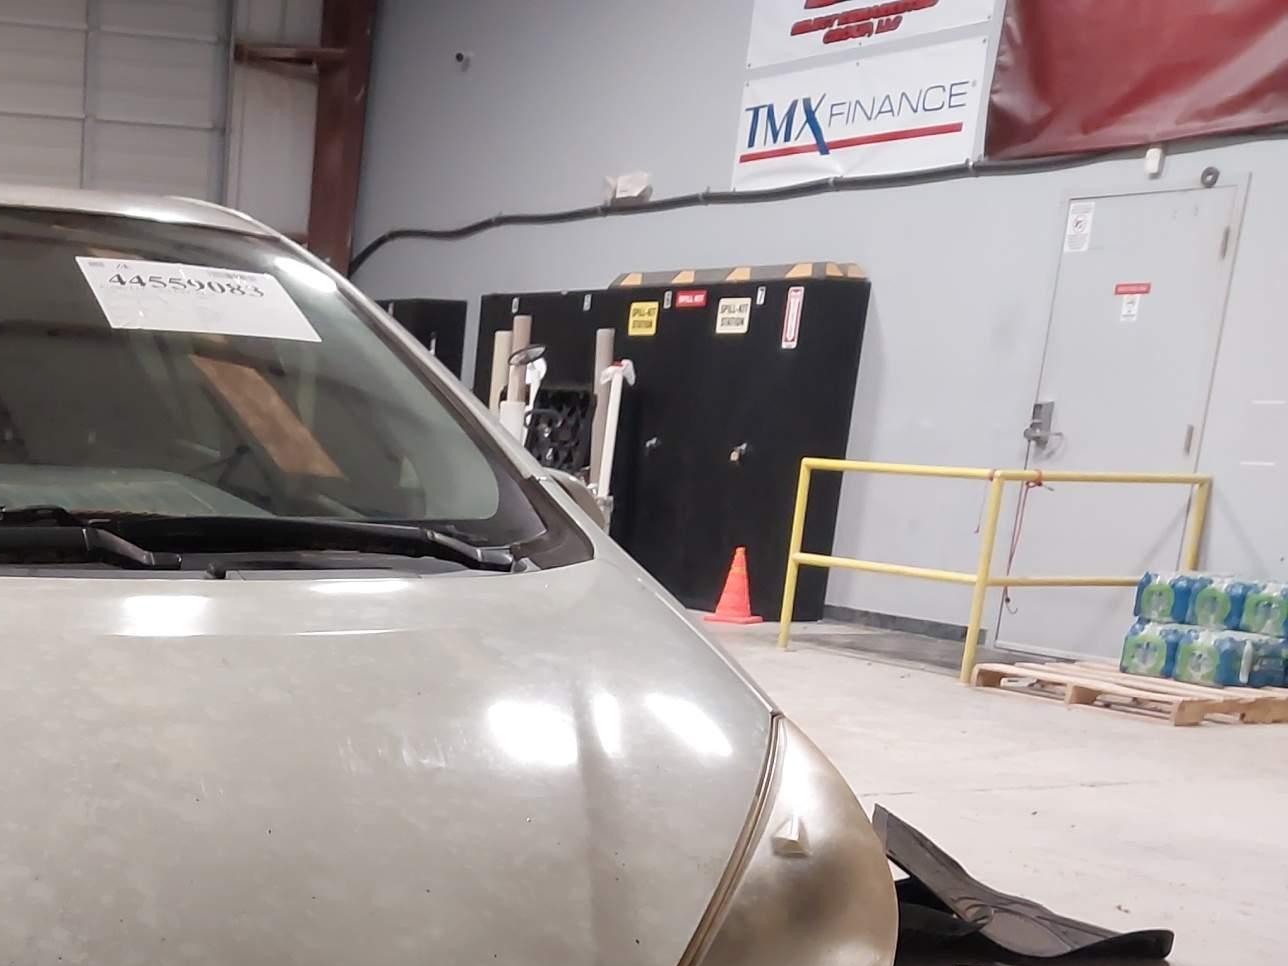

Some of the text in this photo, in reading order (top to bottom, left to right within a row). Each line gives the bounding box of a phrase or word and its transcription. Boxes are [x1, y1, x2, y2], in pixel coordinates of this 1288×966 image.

[745, 80, 969, 155] TMX FINANCE
[109, 273, 264, 297] 44559083
